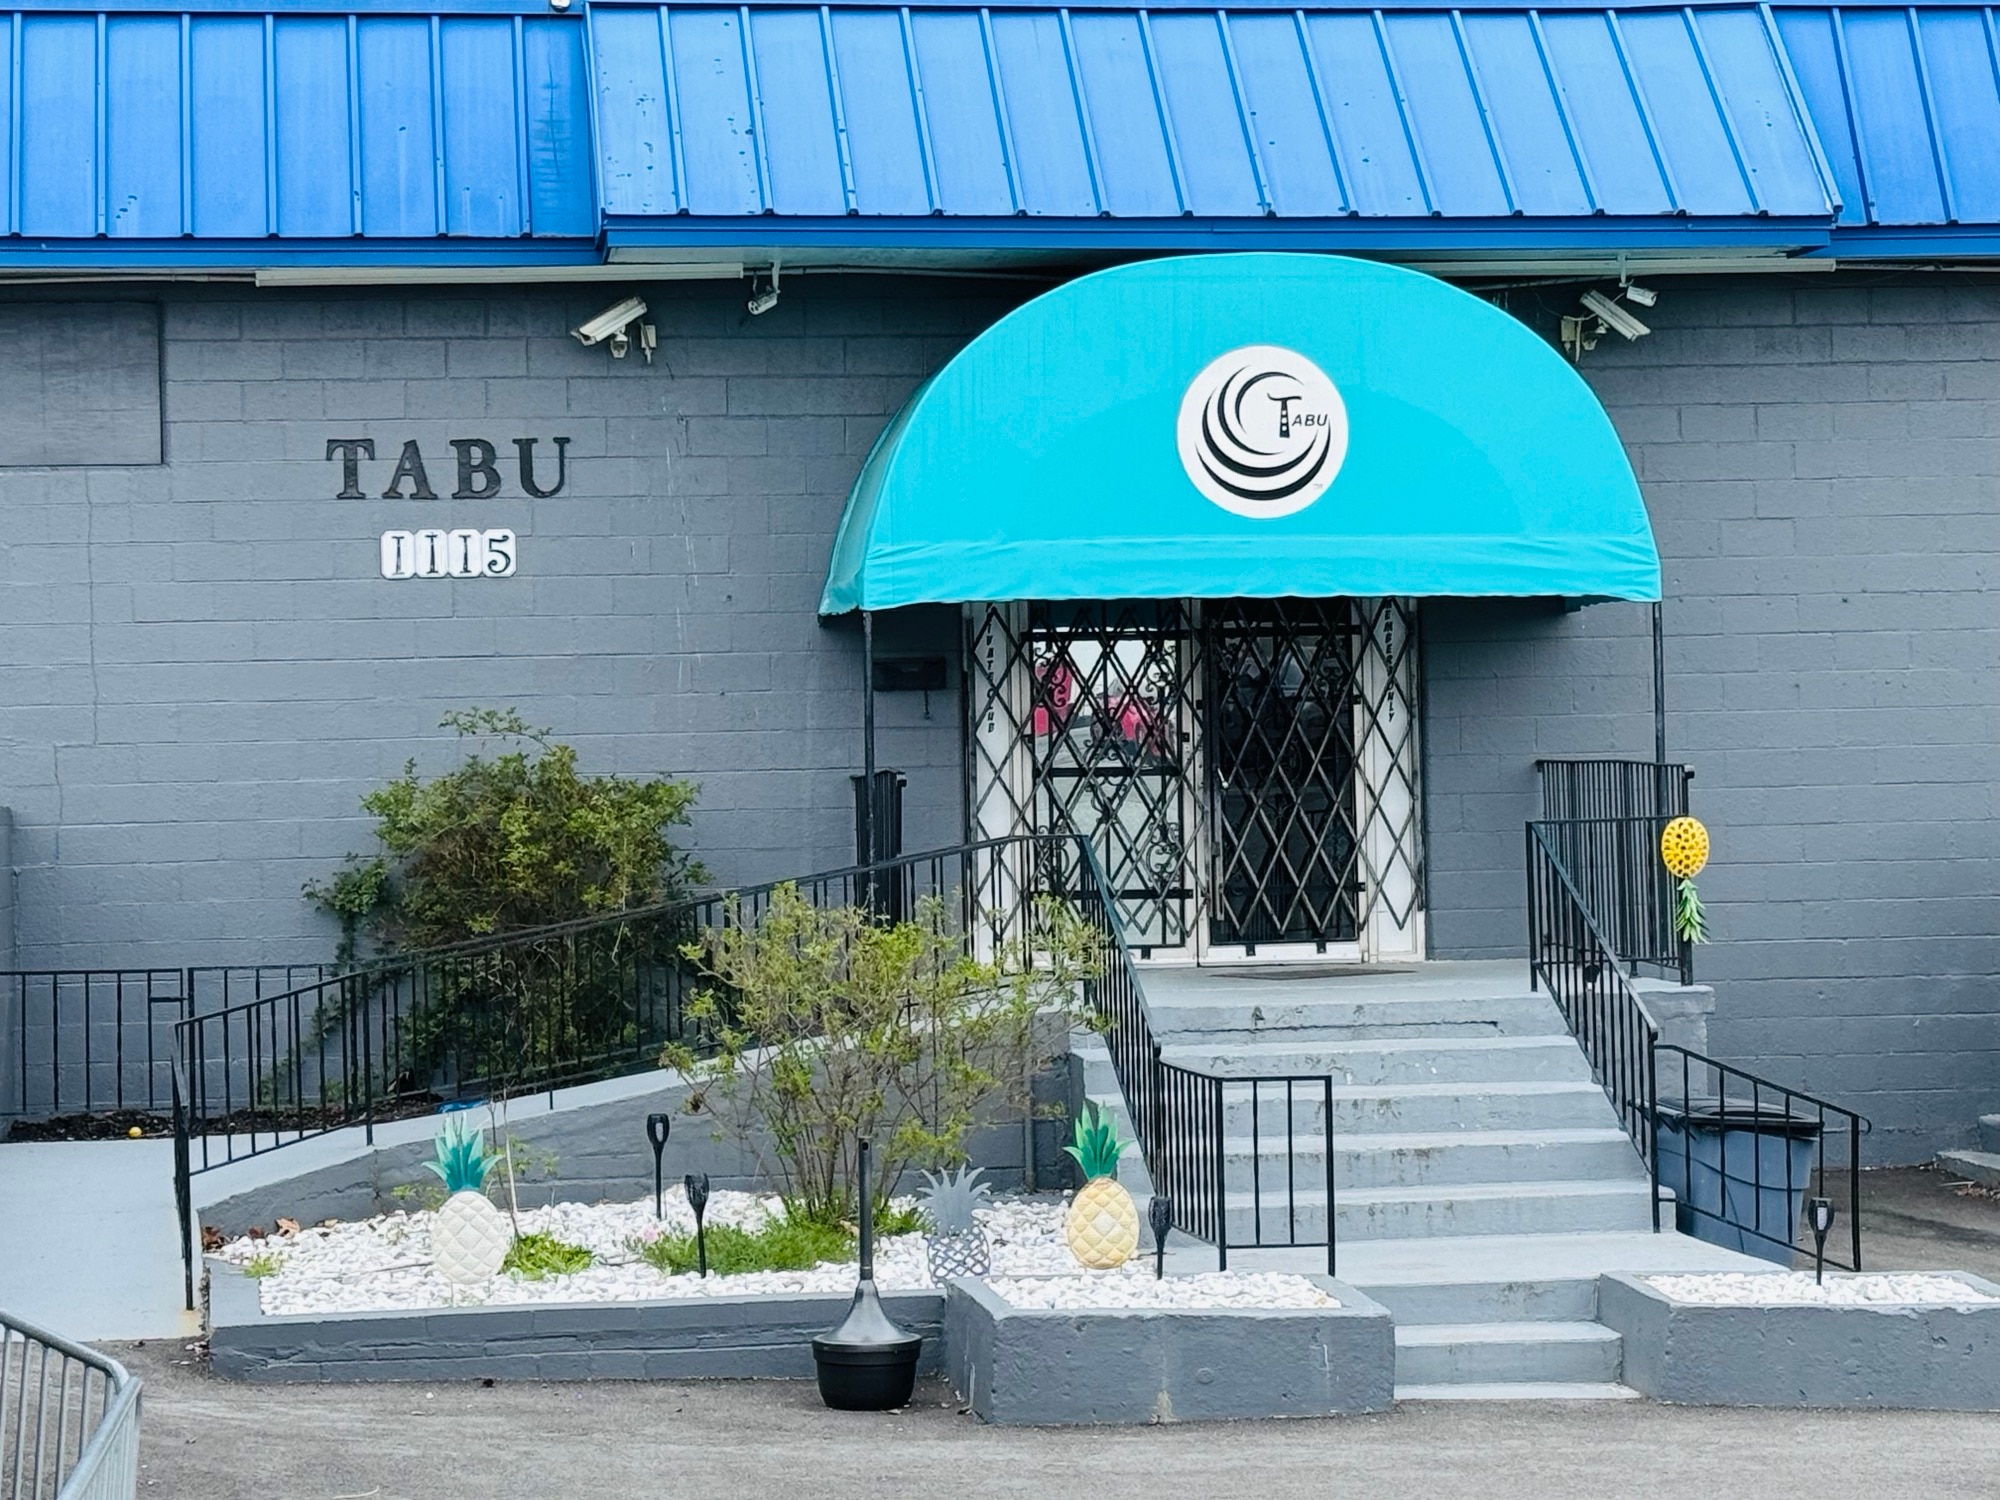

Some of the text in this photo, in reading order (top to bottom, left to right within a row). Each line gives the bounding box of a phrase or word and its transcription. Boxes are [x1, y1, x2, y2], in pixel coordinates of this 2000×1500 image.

[1267, 392, 1328, 439] TABU
[326, 437, 571, 500] TABU
[391, 535, 511, 576] 1115
